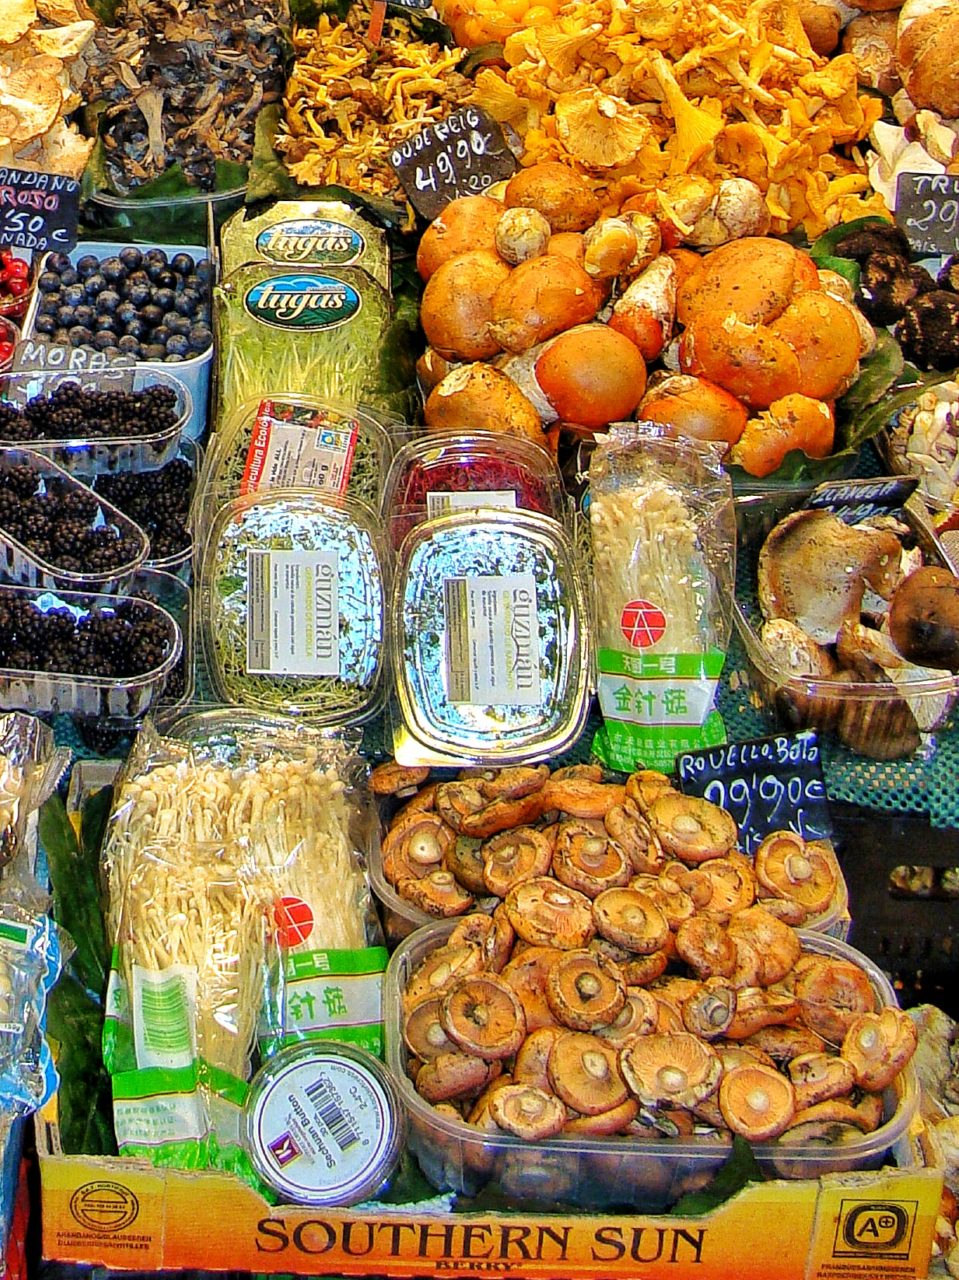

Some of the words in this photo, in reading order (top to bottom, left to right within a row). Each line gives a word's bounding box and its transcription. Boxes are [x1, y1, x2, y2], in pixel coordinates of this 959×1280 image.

[266, 228, 353, 262] tugas
[256, 285, 348, 320] tugas
[316, 563, 337, 659] guzmán
[512, 587, 538, 690] guzmán
[287, 1094, 311, 1127] Button
[308, 1122, 337, 1169] Sechuan
[255, 1220, 572, 1264] SOUTHERN
[591, 1225, 708, 1265] SUN
[435, 1261, 518, 1272] BERRY
